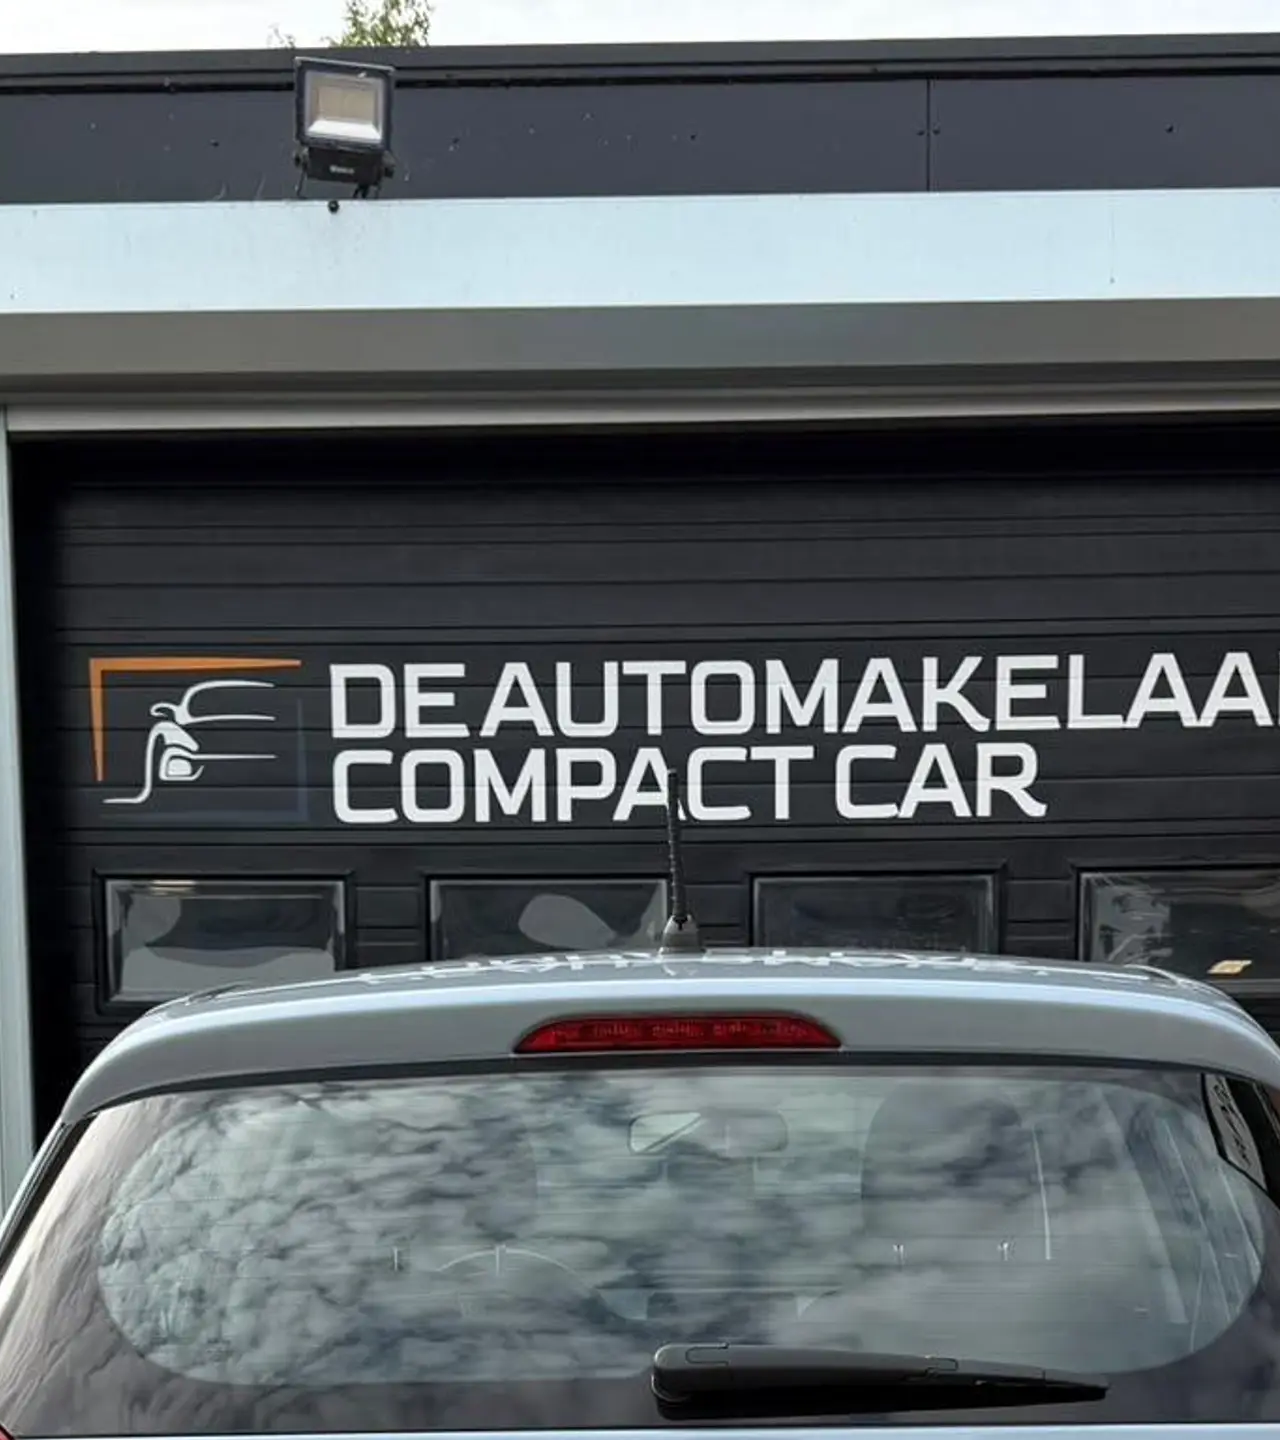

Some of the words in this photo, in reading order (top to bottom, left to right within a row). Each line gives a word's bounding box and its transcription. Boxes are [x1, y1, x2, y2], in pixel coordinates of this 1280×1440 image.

[330, 662, 469, 738] DE
[333, 744, 814, 824] COMPACT
[835, 741, 1049, 820] CAR
